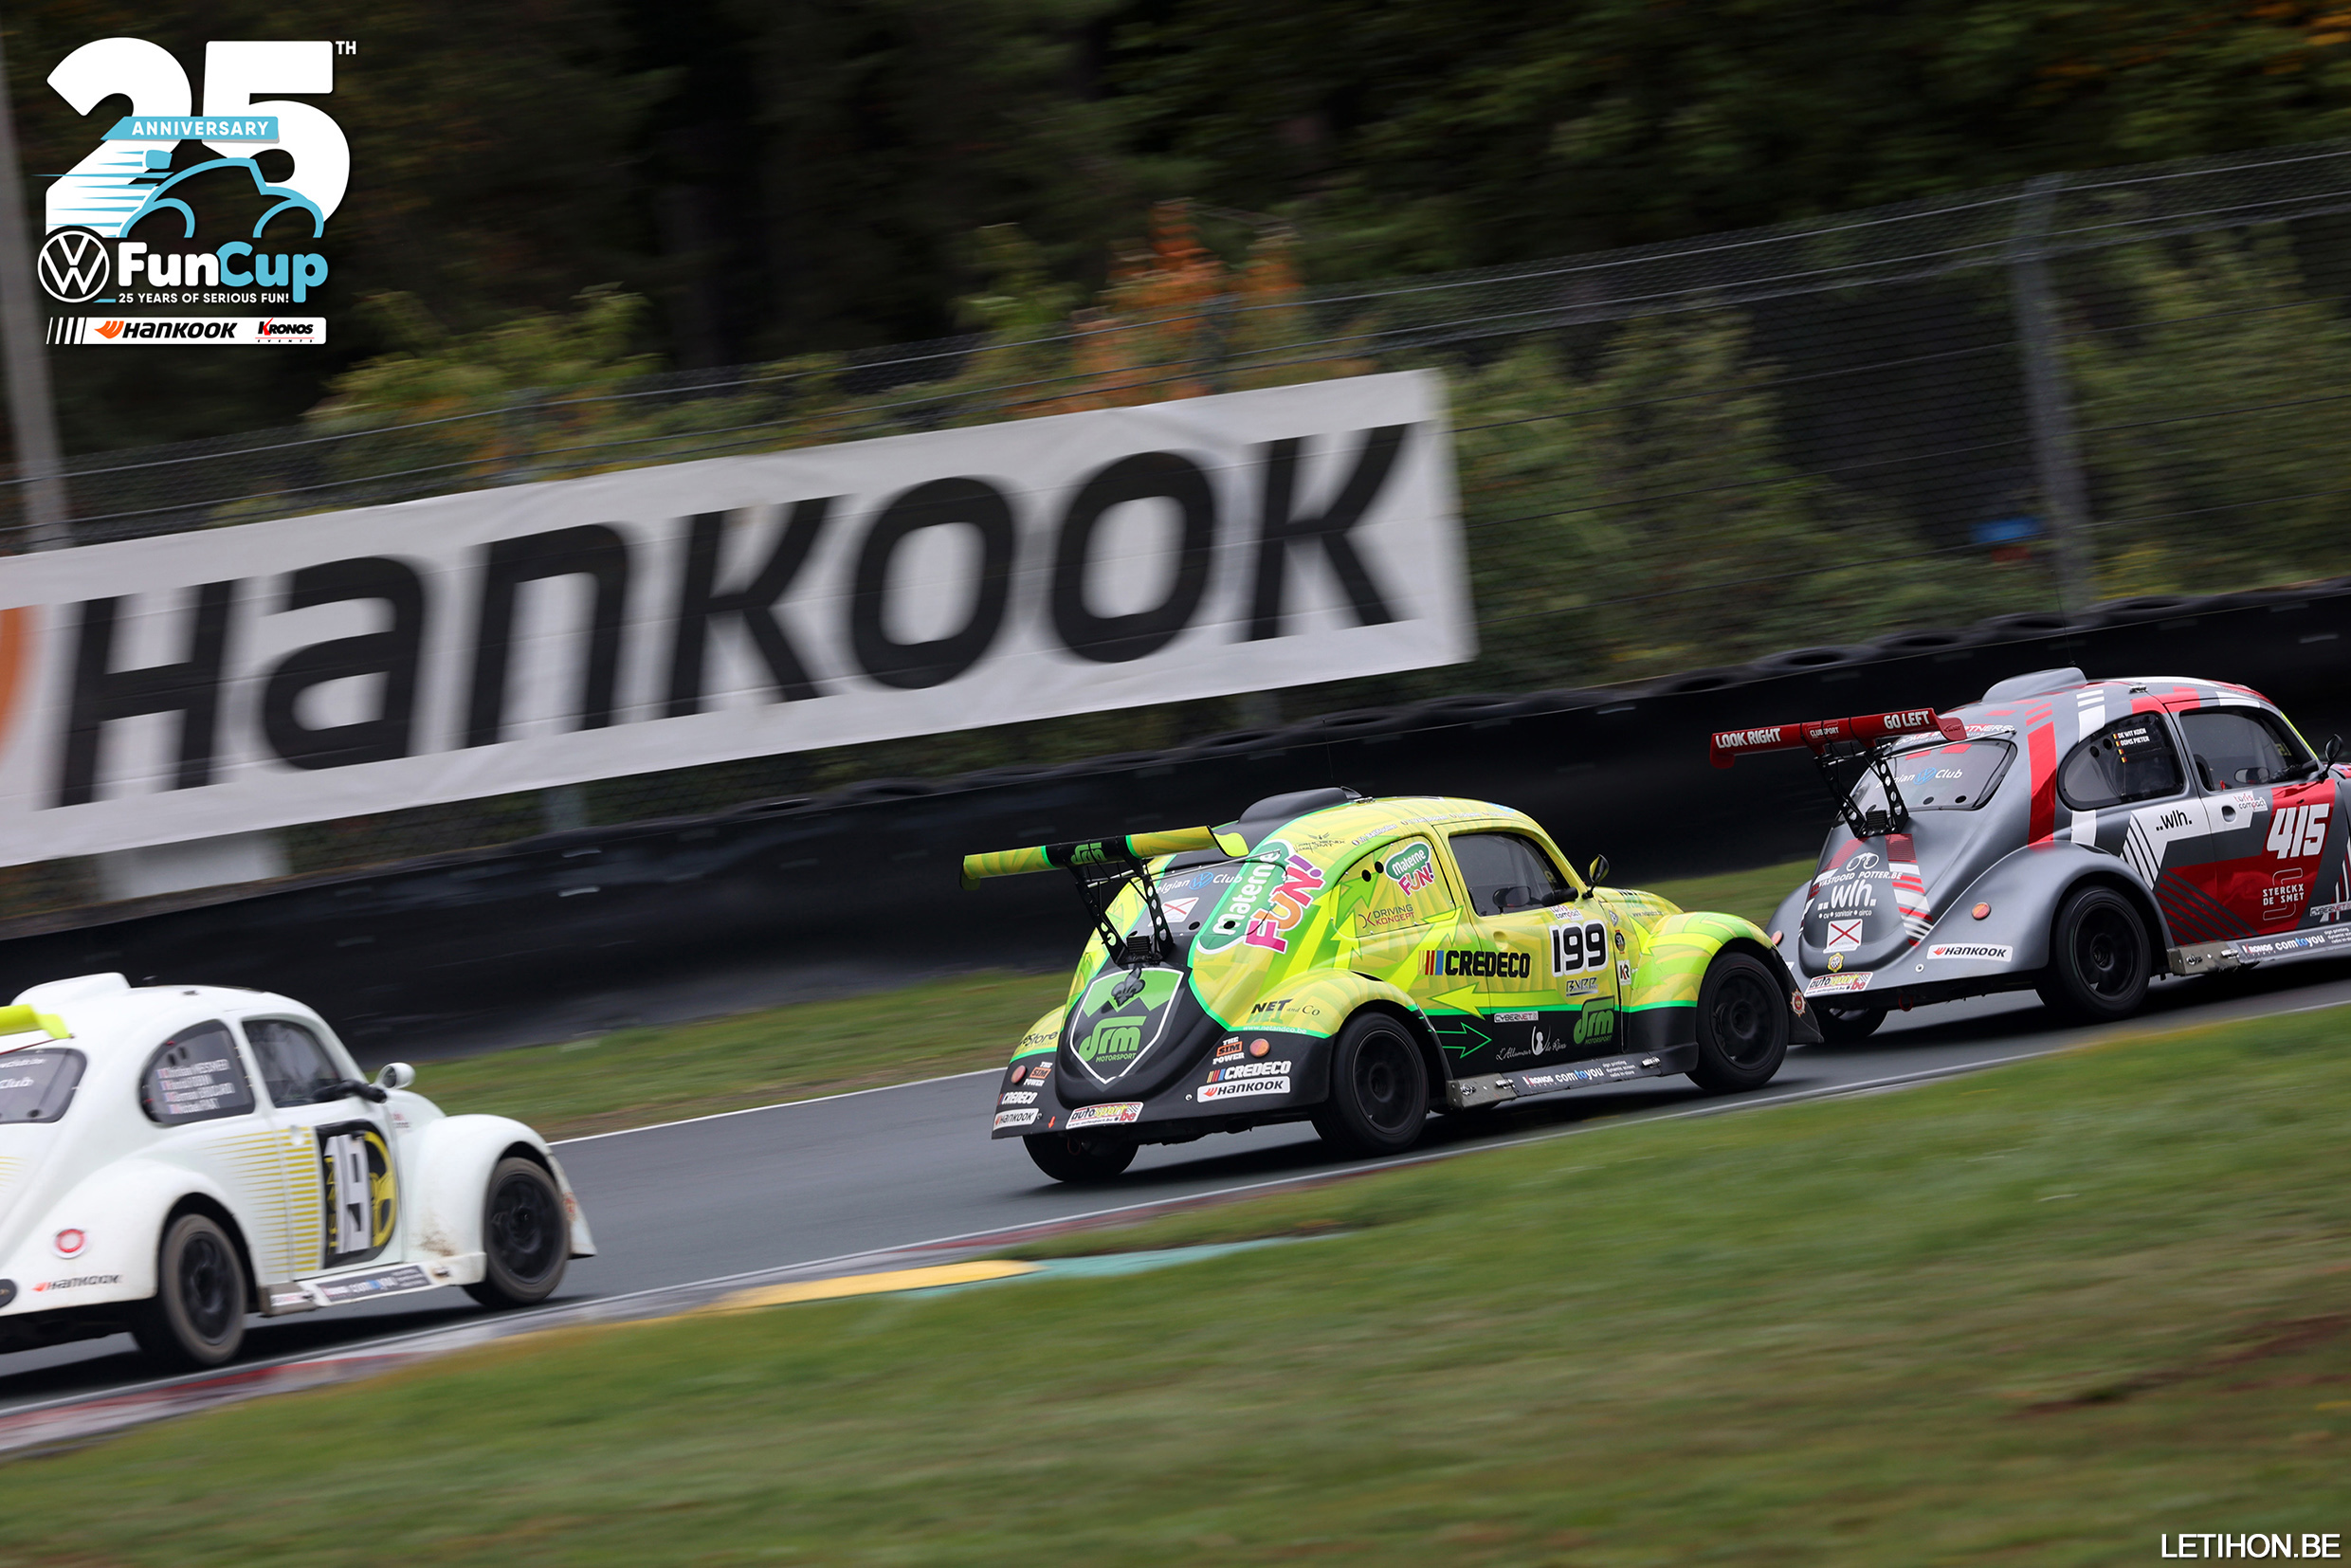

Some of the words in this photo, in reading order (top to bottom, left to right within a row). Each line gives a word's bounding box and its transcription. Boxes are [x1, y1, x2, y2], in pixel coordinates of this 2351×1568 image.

[1884, 713, 1902, 730] GO
[1902, 711, 1929, 727] LEFT
[1715, 732, 1748, 749] LOOK
[1747, 728, 1781, 745] RIGHT
[1935, 769, 1963, 779] Club
[2267, 803, 2330, 859] 415
[1858, 870, 1904, 880] POTTER.BE
[1155, 878, 1191, 894] elgian
[1212, 873, 1243, 884] Club
[2262, 884, 2305, 897] STERCKX
[2263, 897, 2274, 906] DE
[2281, 892, 2305, 903] SMET
[1373, 903, 1413, 919] DRIVING
[1375, 912, 1415, 926] KONCEPT
[1551, 921, 1608, 975] 199
[2275, 935, 2325, 951] comtoyou
[1445, 950, 1531, 978] CREDECO
[1250, 998, 1293, 1014] NET
[1302, 1005, 1321, 1016] Co
[1223, 1036, 1239, 1046] THE
[1095, 1052, 1138, 1063] MOTORSPORT
[1218, 1044, 1241, 1055] SIM
[1212, 1052, 1245, 1065] POWER
[1224, 1060, 1292, 1081] CREDECO
[1555, 1067, 1604, 1084] comtoyou
[1001, 1091, 1038, 1105] CREDECO
